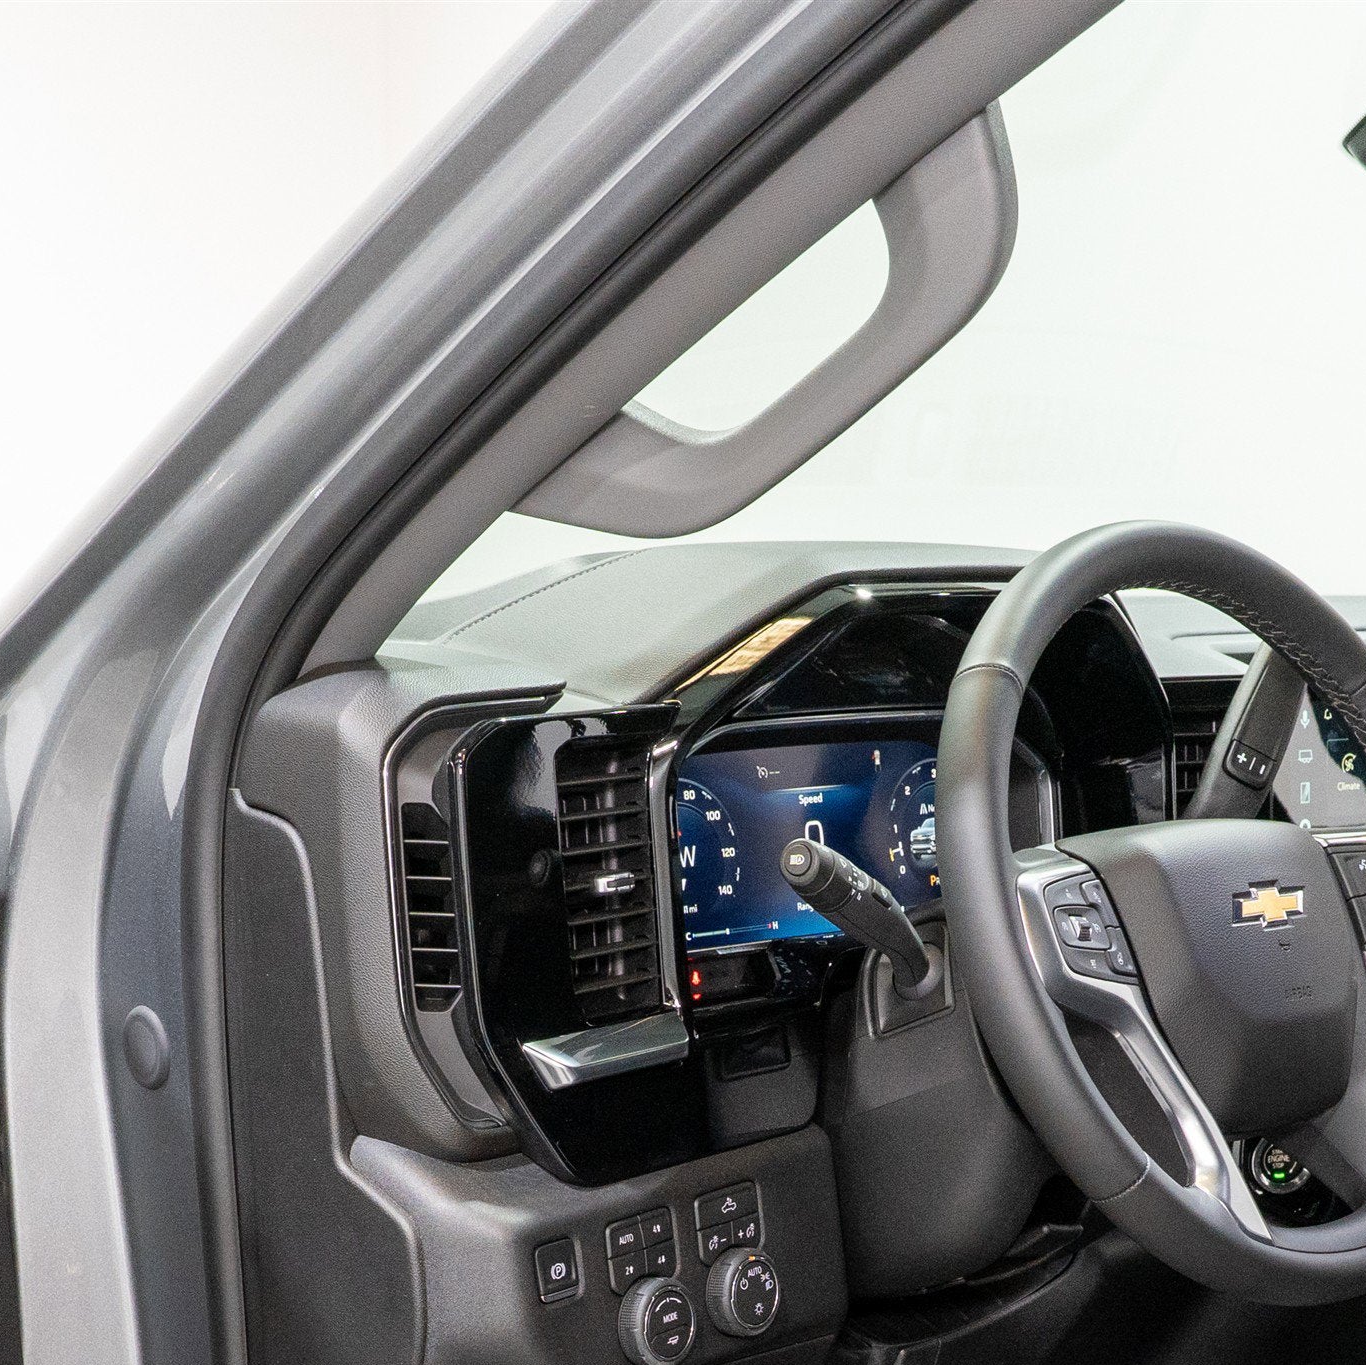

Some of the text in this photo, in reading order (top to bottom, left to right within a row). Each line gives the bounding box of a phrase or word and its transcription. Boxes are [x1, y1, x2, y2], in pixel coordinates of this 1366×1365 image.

[904, 785, 911, 796] 2
[1337, 780, 1361, 791] Climate
[683, 790, 696, 801] 80
[798, 792, 823, 806] Speed
[706, 810, 721, 821] 100
[721, 847, 736, 858] 120
[899, 865, 906, 875] 0
[718, 884, 733, 896] 140
[797, 902, 814, 913] Rang
[772, 920, 779, 930] H
[685, 932, 692, 941] C
[1267, 1154, 1291, 1164] ENGINE
[619, 1233, 634, 1246] AUTO
[747, 1266, 763, 1278] AUTO
[663, 1311, 678, 1324] MODE
